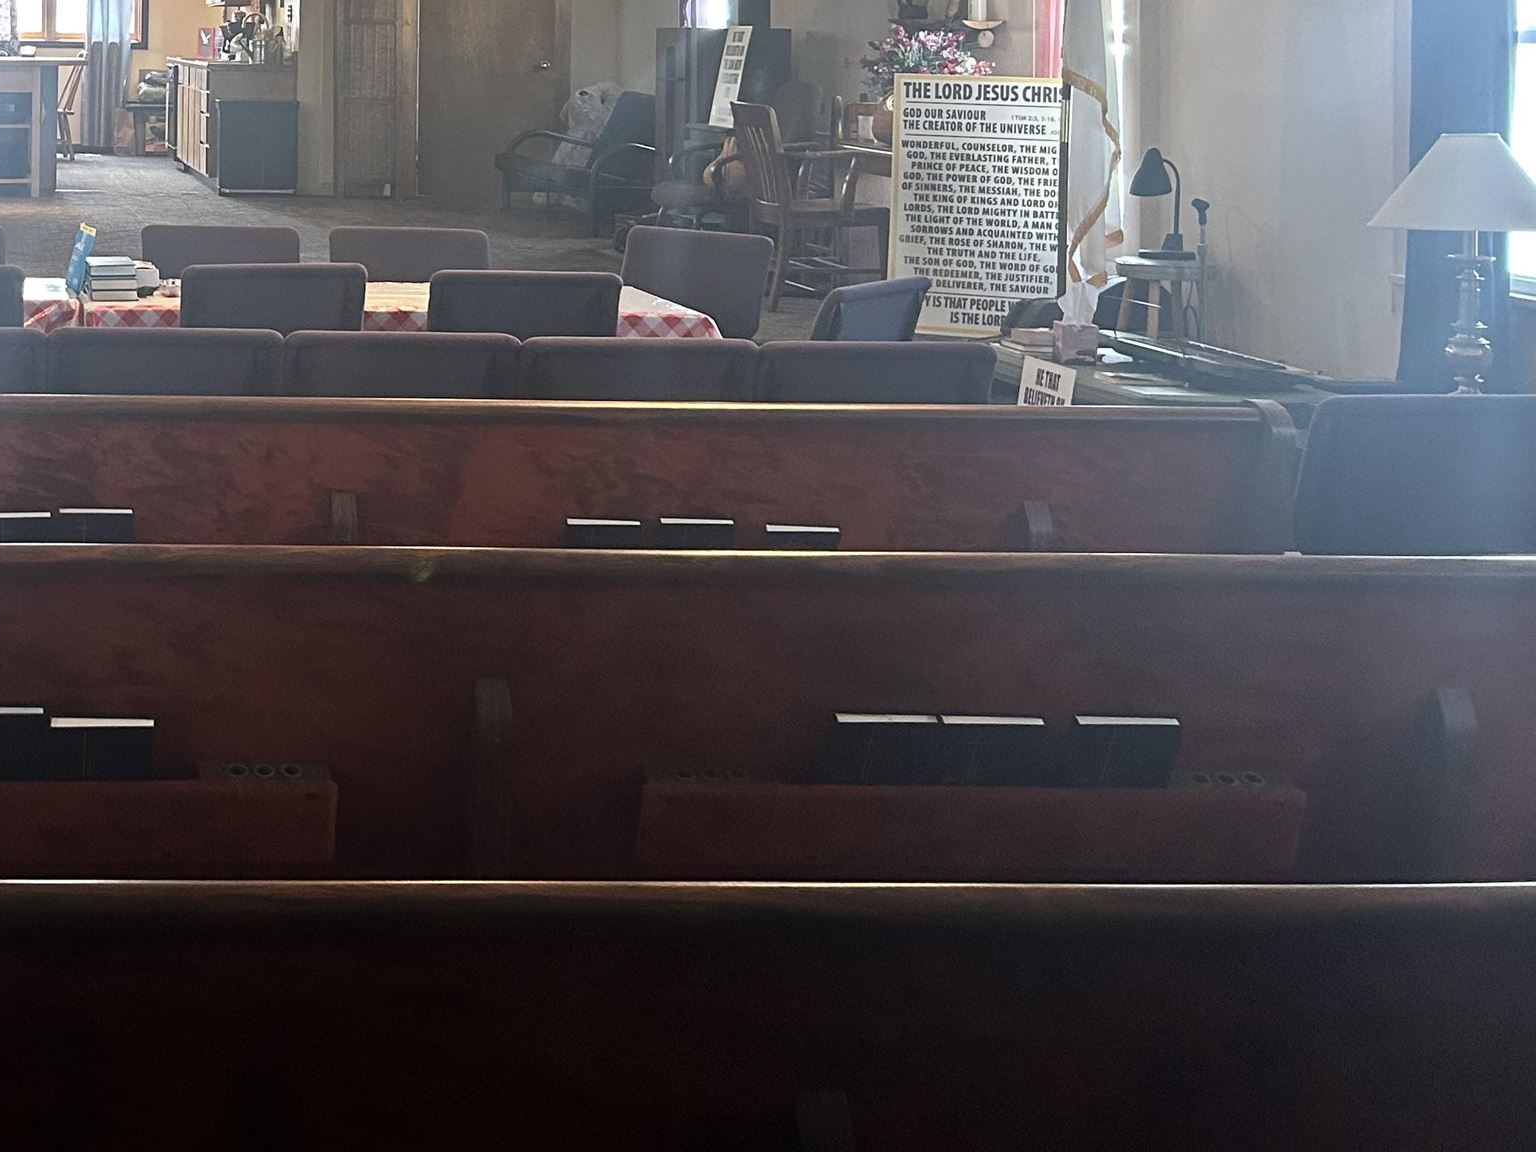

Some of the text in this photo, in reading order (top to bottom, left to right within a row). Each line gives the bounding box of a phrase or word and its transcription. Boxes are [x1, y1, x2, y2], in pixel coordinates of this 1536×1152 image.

[904, 82, 931, 98] THE
[935, 83, 972, 99] LORD
[976, 85, 1018, 101] JESUS
[903, 108, 986, 121] GOD OUR SAVIOUR
[903, 120, 1046, 135] THE CREATOR OF THE UNIVERSE
[902, 140, 959, 151] WONDERFUL,
[962, 142, 1017, 153] COUNSELOR,
[1020, 145, 1036, 154] THE
[907, 151, 927, 160] GOD,
[930, 152, 946, 160] THE
[949, 153, 1009, 163] EVERLASTING
[1012, 156, 1049, 165] FATHER,
[911, 162, 943, 171] PRINCE
[946, 163, 956, 171] OF
[959, 163, 989, 174] PEACE,
[992, 165, 1009, 174] THE
[1012, 166, 1049, 176] WISDOM
[903, 172, 924, 181] GOD,
[927, 173, 943, 181] THE
[946, 174, 977, 183] POWER
[980, 176, 991, 184] OF
[994, 176, 1015, 186] GOD,
[1018, 178, 1035, 186] THE
[902, 182, 912, 190] OF
[915, 183, 956, 193] SINNERS,
[959, 185, 975, 194] THE
[978, 186, 1021, 197] MESSIAH,
[1024, 188, 1040, 197] THE
[914, 193, 930, 202] THE
[933, 194, 954, 203] KING
[957, 195, 968, 204] OF
[970, 196, 997, 205] KINGS
[1000, 197, 1019, 206] AND
[1022, 199, 1045, 208] LORD
[904, 204, 935, 214] LORDS,
[938, 205, 954, 214] THE
[956, 206, 979, 215] LORD
[982, 207, 1017, 218] MIGHTY
[1020, 209, 1030, 218] IN
[906, 214, 922, 223] THE
[924, 215, 950, 224] LIGHT
[953, 216, 964, 225] OF
[966, 218, 983, 226] THE
[986, 218, 1020, 229] WORLD,
[1023, 220, 1029, 229] A
[1032, 221, 1052, 230] MAN
[911, 225, 953, 235] SORROWS
[956, 226, 974, 236] AND
[977, 228, 1033, 240] ACQUAINTED
[899, 235, 926, 245] GRIEF,
[929, 236, 946, 245] THE
[949, 238, 970, 247] ROSE
[973, 239, 984, 248] OF
[987, 240, 1027, 251] SHARON,
[1029, 242, 1046, 251] THE
[927, 247, 1041, 263] THE TRUTH AND THE LIFE,
[904, 256, 920, 265] THE
[922, 257, 940, 266] SON
[942, 258, 953, 266] OF
[956, 259, 976, 269] GOD,
[980, 261, 996, 270] THE
[999, 262, 1026, 271] WORD
[1029, 264, 1040, 272] OF
[914, 267, 1052, 285] THE REDEEMER, THE JUSTIFIER,
[936, 279, 987, 291] DELIVERER,
[990, 283, 1007, 292] THE
[1009, 284, 1049, 295] SAVIOUR
[932, 296, 942, 308] IS
[944, 296, 966, 310] THAT
[970, 299, 1006, 312] PEOPLE
[950, 312, 959, 323] IS
[962, 313, 979, 325] THE
[1045, 370, 1061, 392] THAT
